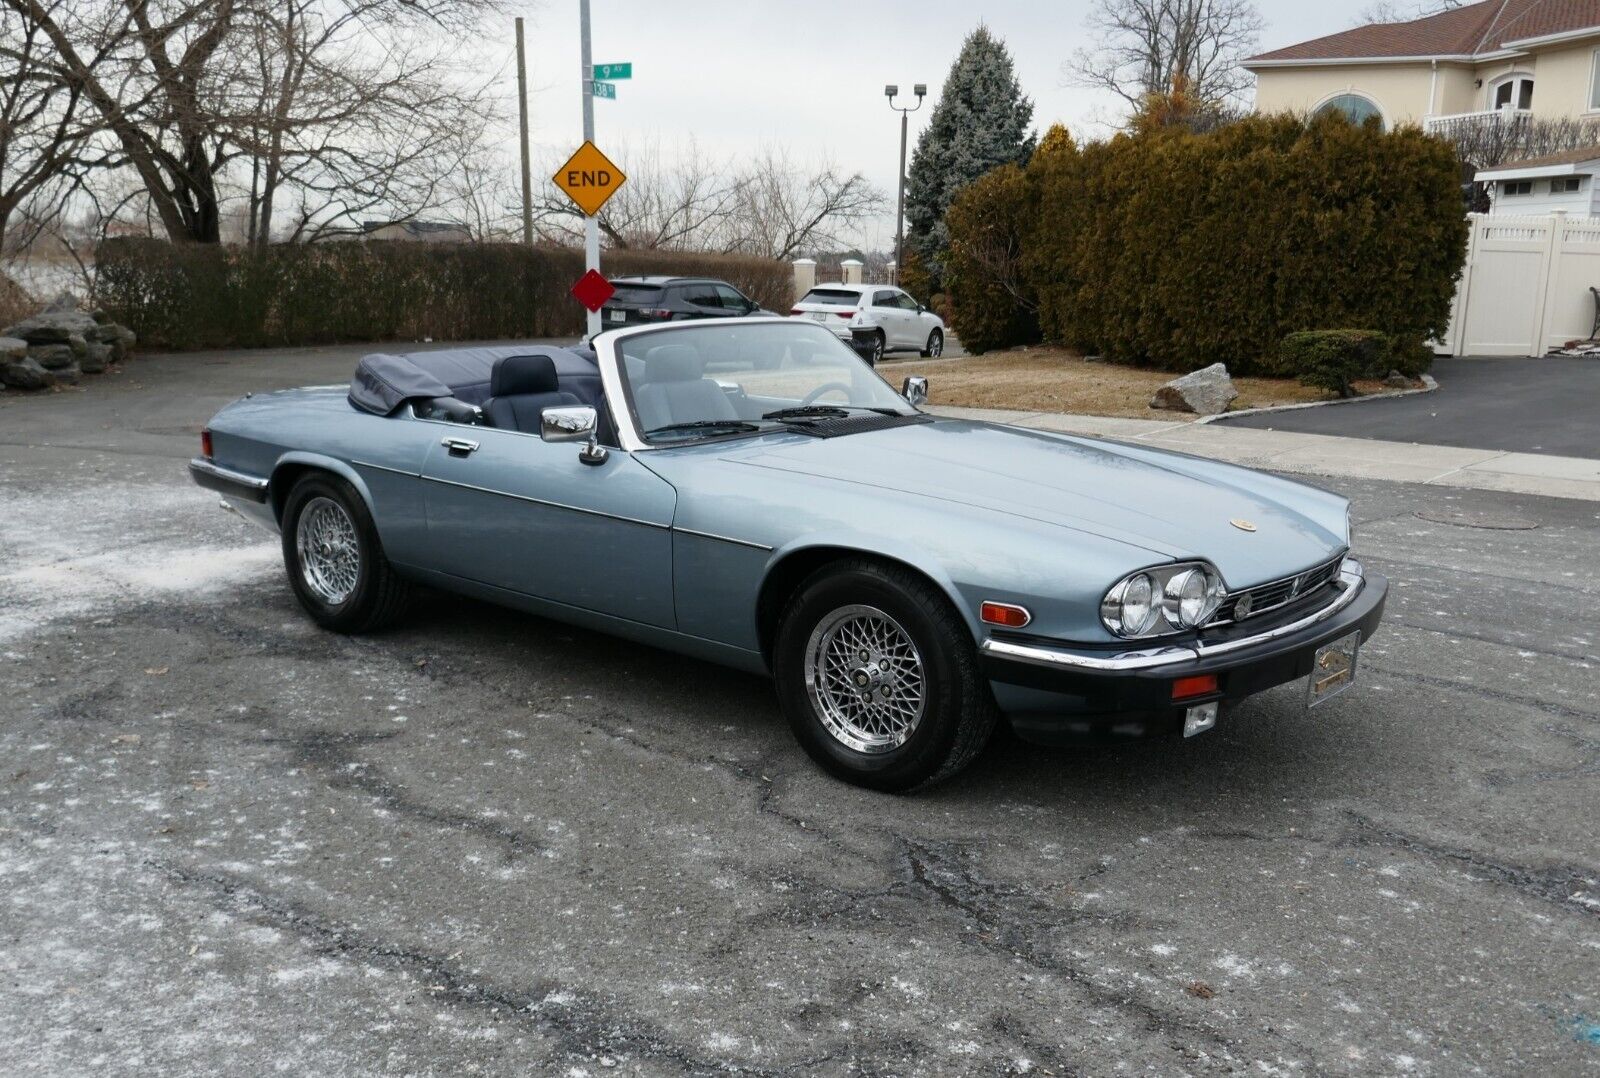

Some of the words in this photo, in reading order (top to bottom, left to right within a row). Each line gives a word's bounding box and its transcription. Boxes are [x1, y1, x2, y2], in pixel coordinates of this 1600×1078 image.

[602, 66, 610, 78] 9
[613, 65, 623, 73] AV
[593, 82, 608, 97] 138
[568, 171, 610, 187] END
